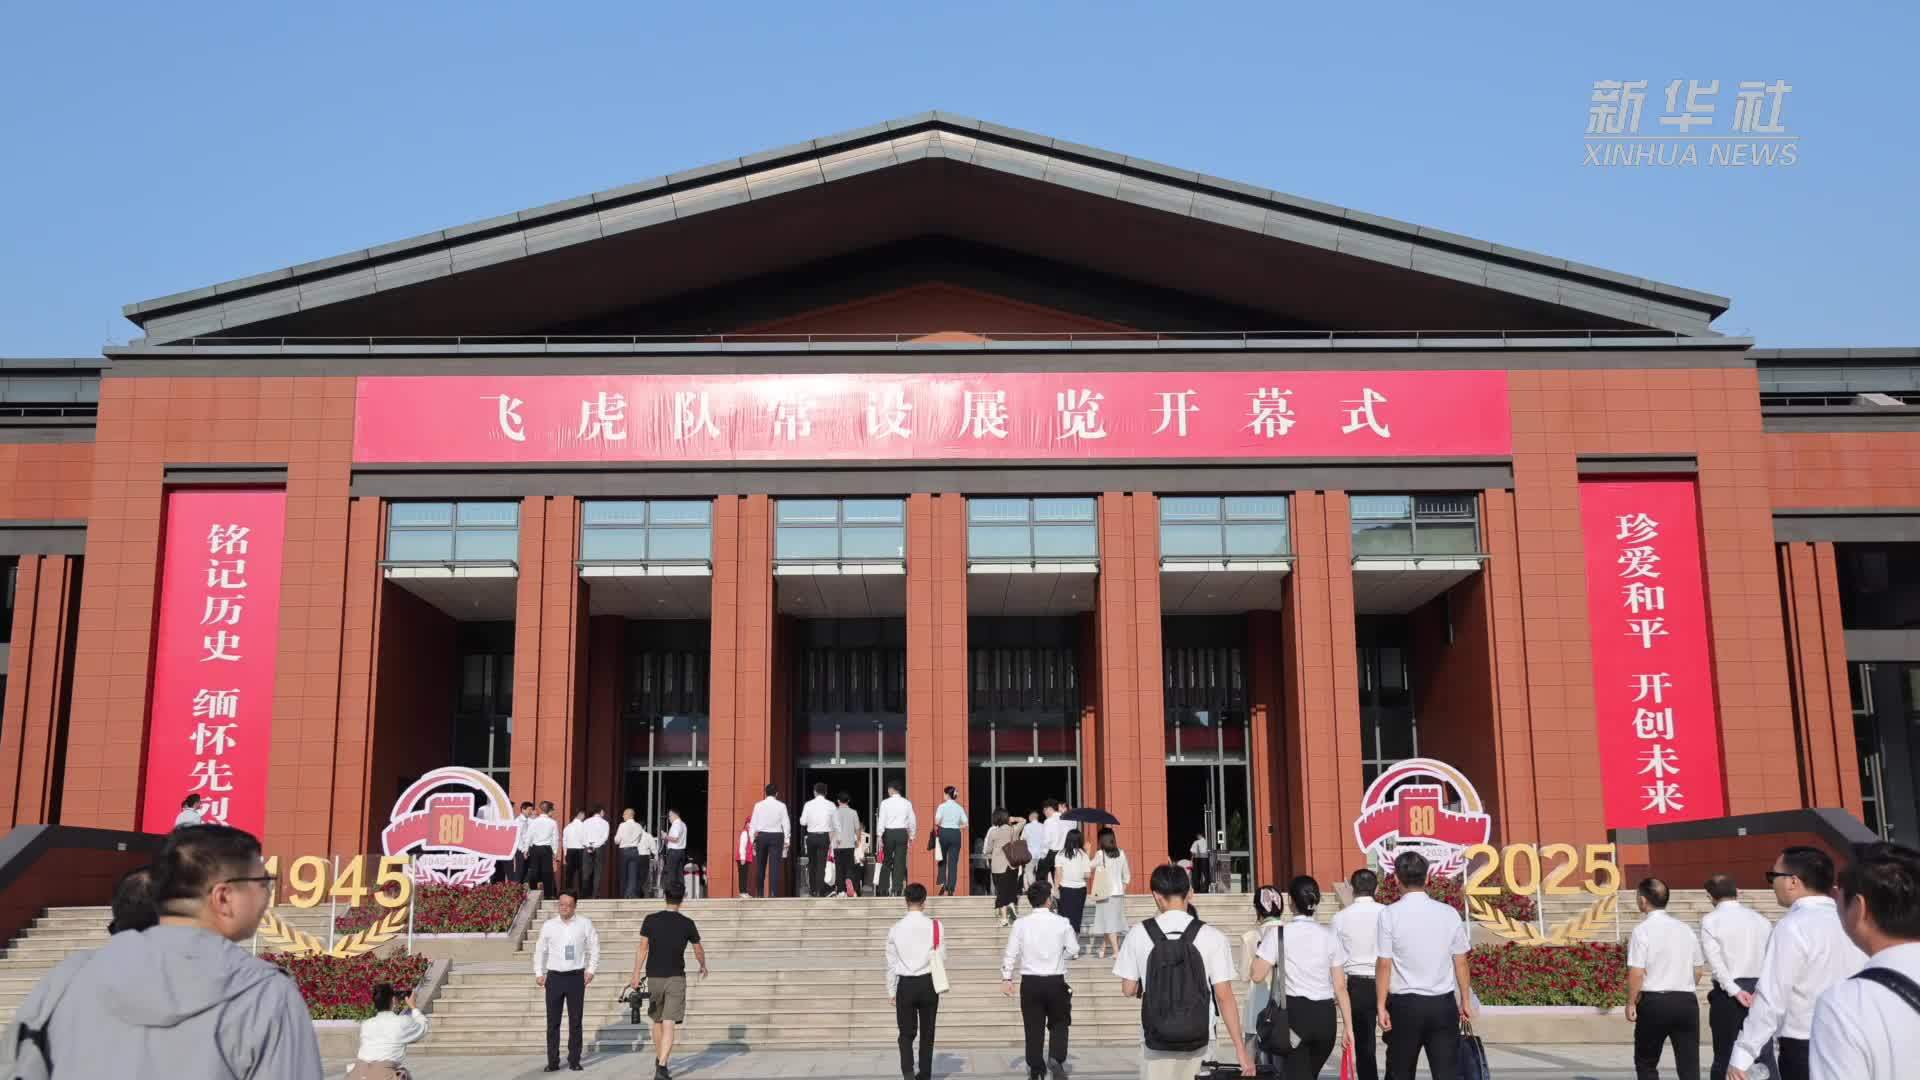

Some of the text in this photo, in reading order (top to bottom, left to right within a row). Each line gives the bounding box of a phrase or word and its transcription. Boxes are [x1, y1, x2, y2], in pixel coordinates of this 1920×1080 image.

[479, 387, 1392, 442] 飞虎队常设展览开幕式
[200, 523, 250, 663] 铭记历史
[1615, 512, 1685, 815] 珍爱和平 开创未来
[439, 814, 464, 844] 80
[1409, 805, 1435, 836] 80
[1464, 843, 1621, 896] 2025
